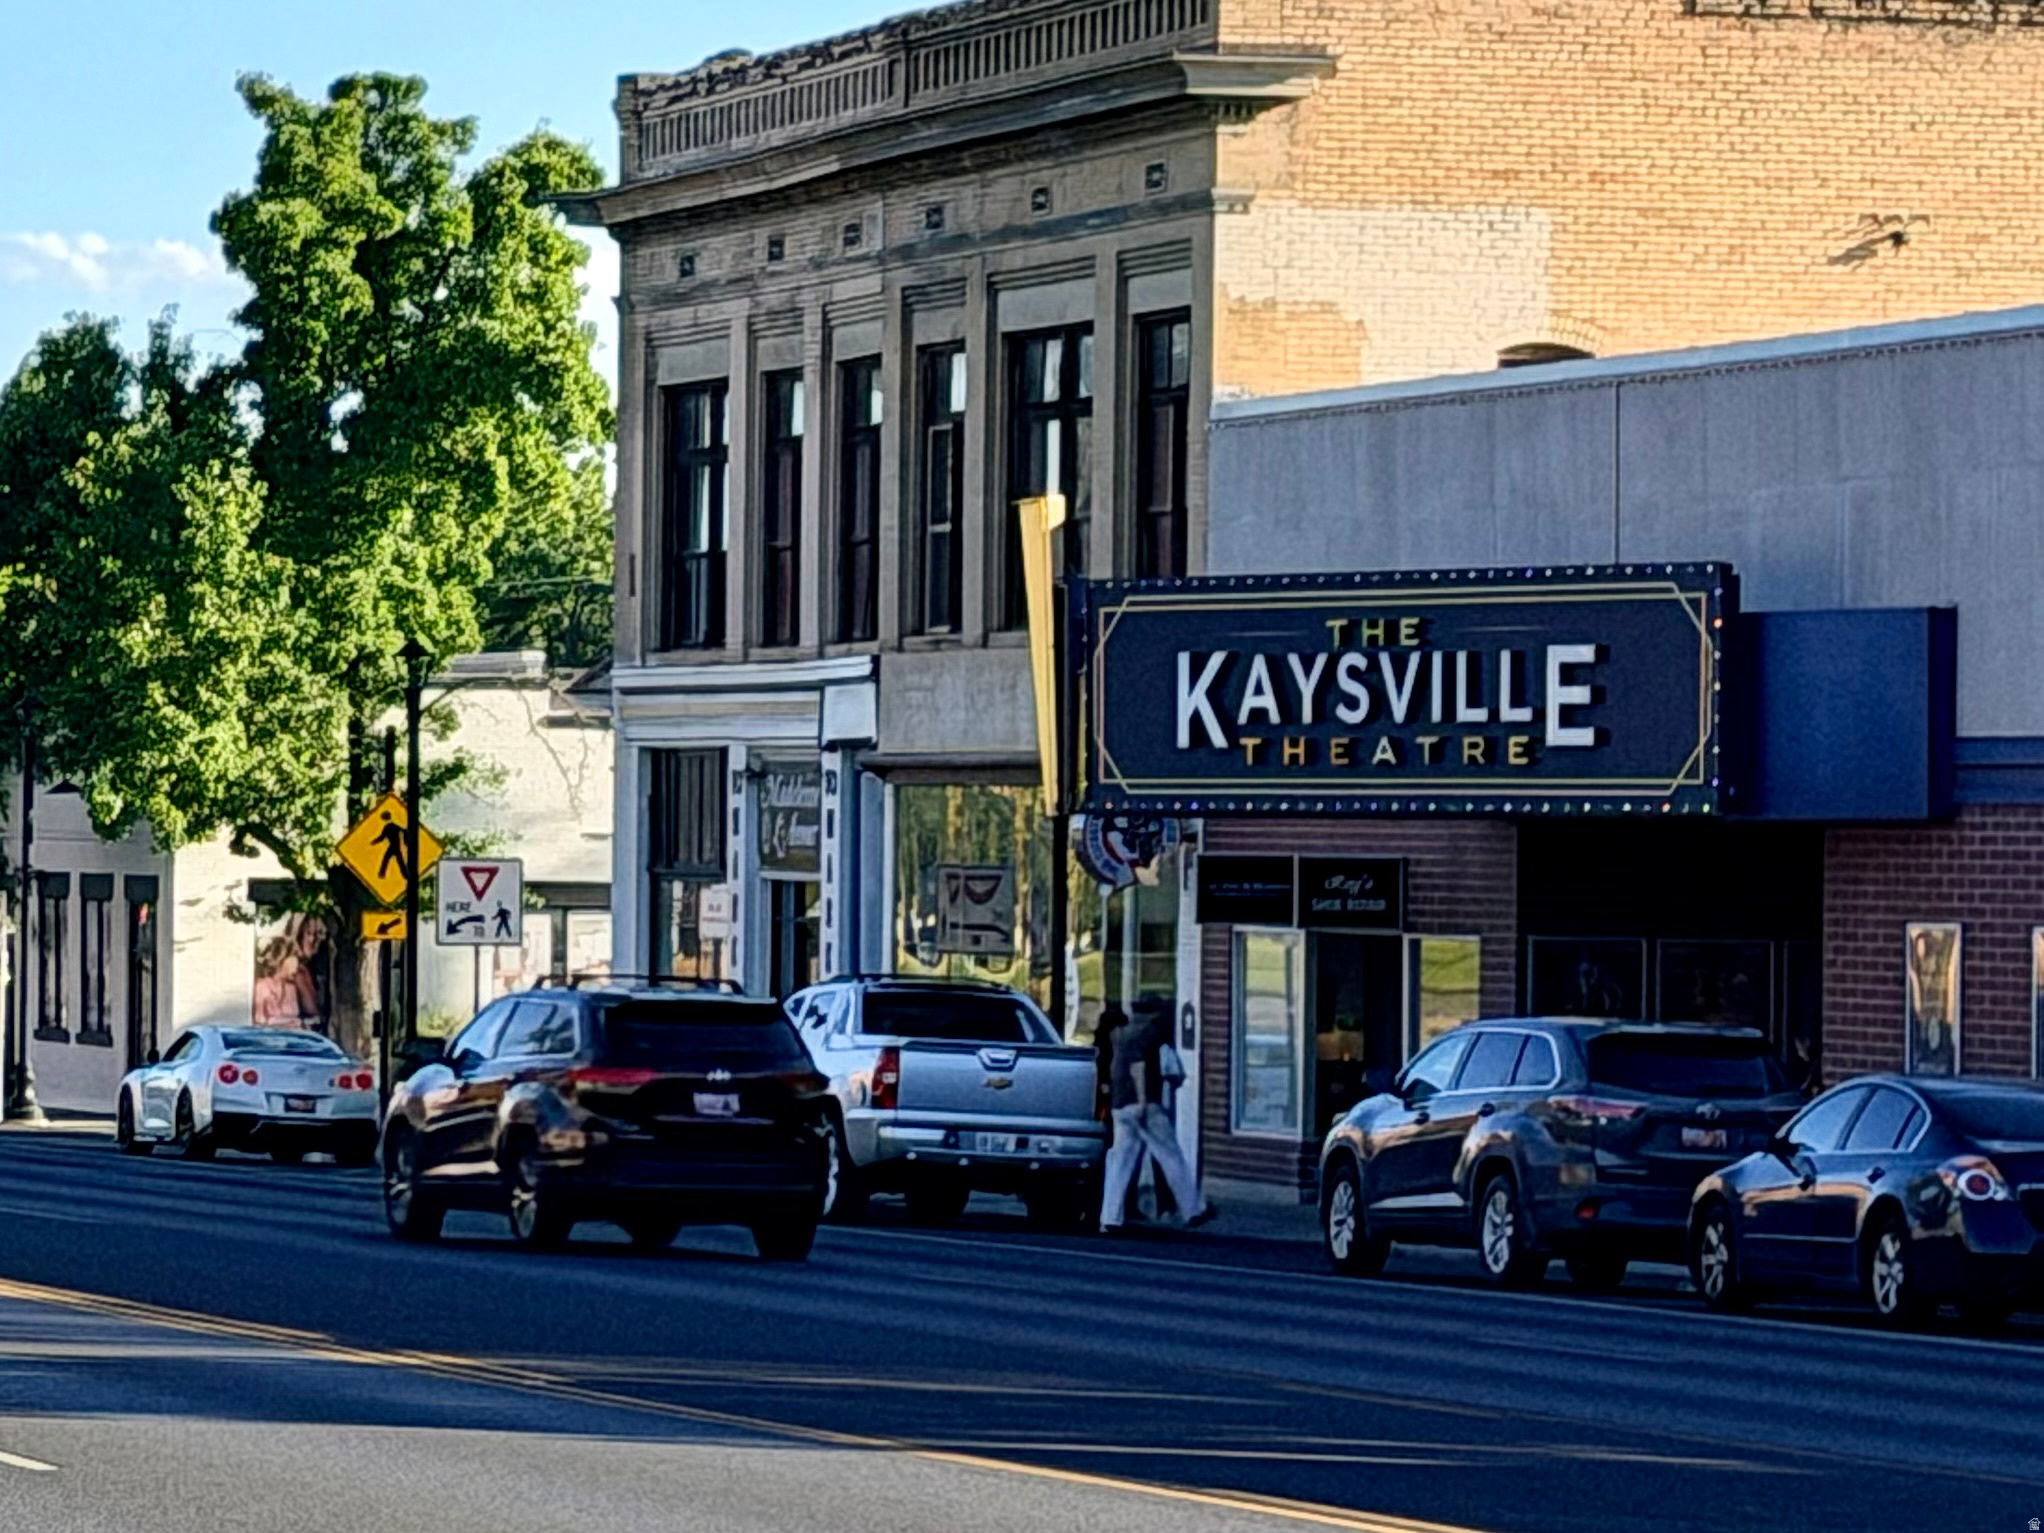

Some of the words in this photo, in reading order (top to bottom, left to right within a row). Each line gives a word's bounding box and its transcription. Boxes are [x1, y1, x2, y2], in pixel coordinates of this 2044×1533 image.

[1325, 615, 1420, 647] THE
[1176, 644, 1596, 749] KAYSVILLE
[1239, 735, 1531, 767] THEATRE
[446, 901, 472, 912] HERE
